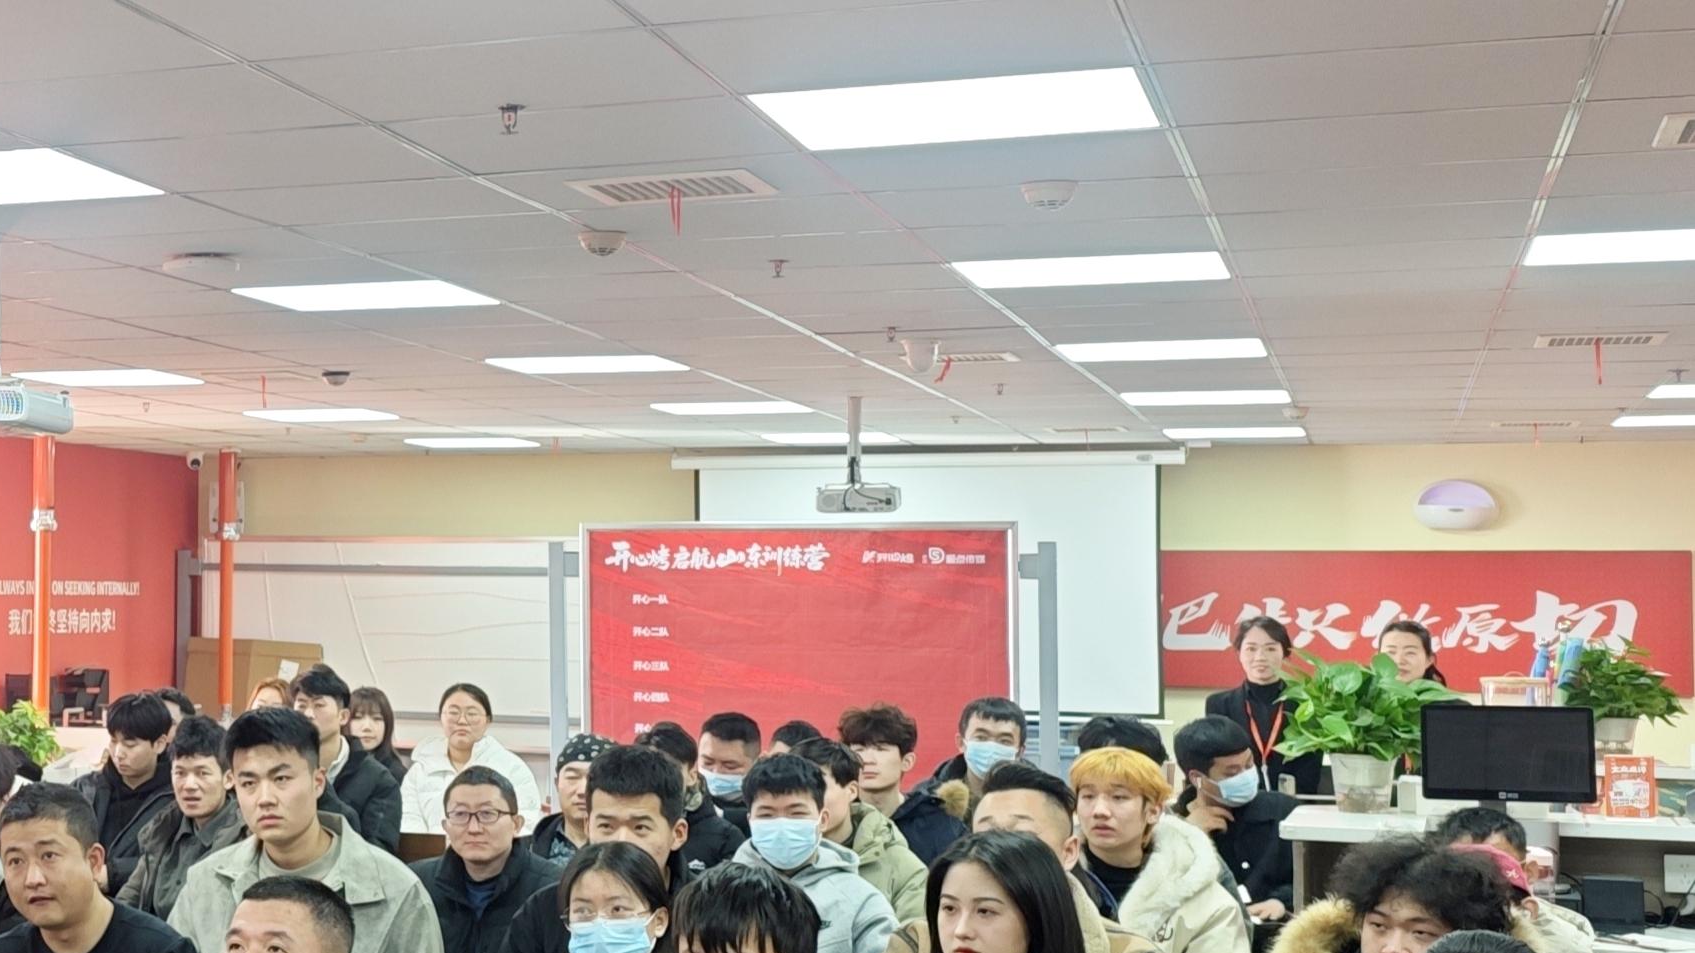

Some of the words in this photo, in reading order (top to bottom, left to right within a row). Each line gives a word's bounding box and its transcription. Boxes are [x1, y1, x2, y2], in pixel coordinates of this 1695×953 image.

[51, 581, 64, 595] ON
[64, 581, 96, 596] SEEKING
[632, 594, 669, 605] 开心一队
[8, 608, 116, 635] 我们终坚持向内求!
[632, 626, 669, 637] 开心二队
